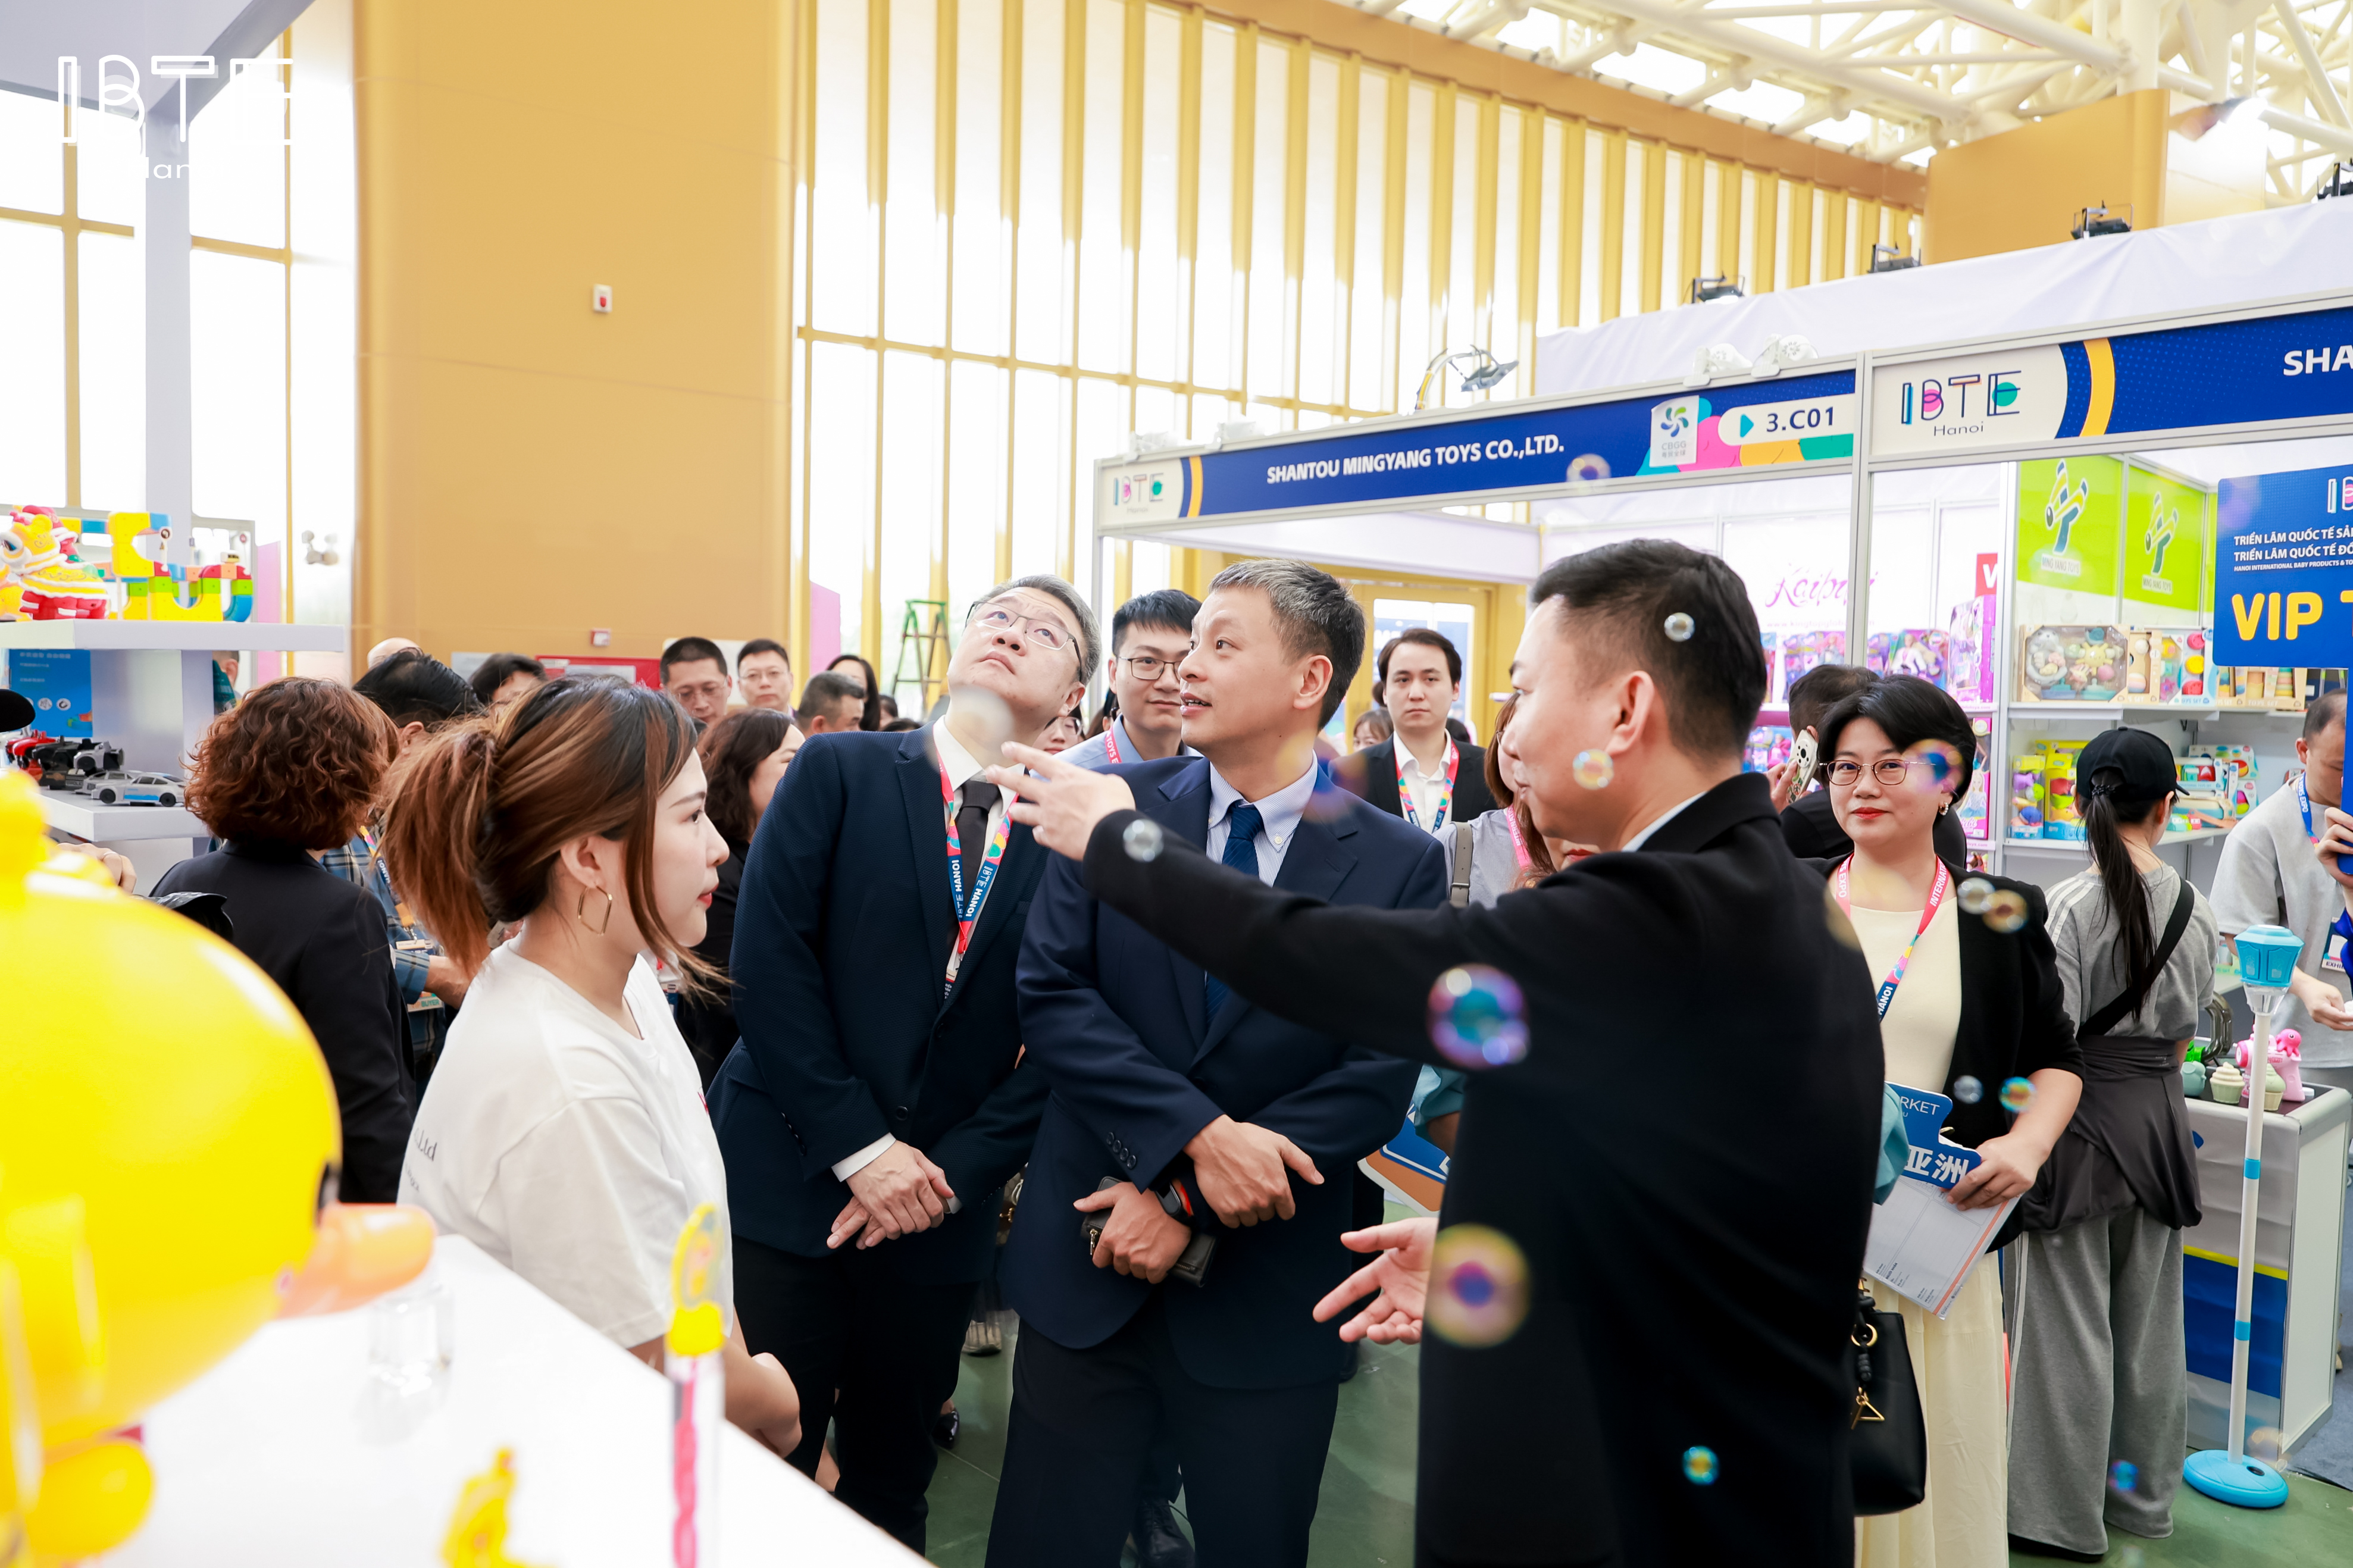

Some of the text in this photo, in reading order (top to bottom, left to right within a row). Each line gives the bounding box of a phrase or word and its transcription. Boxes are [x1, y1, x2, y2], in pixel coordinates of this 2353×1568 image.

[1901, 370, 2022, 424] IBTE
[1766, 407, 1833, 432] 3.C01
[1934, 421, 1984, 436] Hanoi
[1662, 440, 1687, 450] CBGG
[1267, 434, 1565, 484] SHANTOU MINGYANG TOYS CO.,LTD.
[1113, 472, 1164, 506] IBTE
[2234, 531, 2263, 546] TRIỂN
[2264, 531, 2286, 544] LÃM
[2288, 527, 2320, 543] QUỐC
[2321, 525, 2335, 539] TẾ
[2234, 547, 2263, 561] TRIỂN
[2264, 547, 2287, 560] LÃM
[2289, 544, 2321, 559] QUỐC
[2323, 542, 2337, 556] TẾ
[2042, 556, 2079, 574] MING YANG TOYS
[2232, 591, 2323, 640] VIP
[1106, 736, 1116, 758] TOYS
[952, 859, 962, 892] HANOI
[1838, 872, 1847, 898] EXPO
[965, 866, 993, 917] IBTE HANOI
[421, 999, 439, 1007] BUYER
[1878, 985, 1894, 1015] HANOI
[1900, 1096, 1940, 1115] RKET
